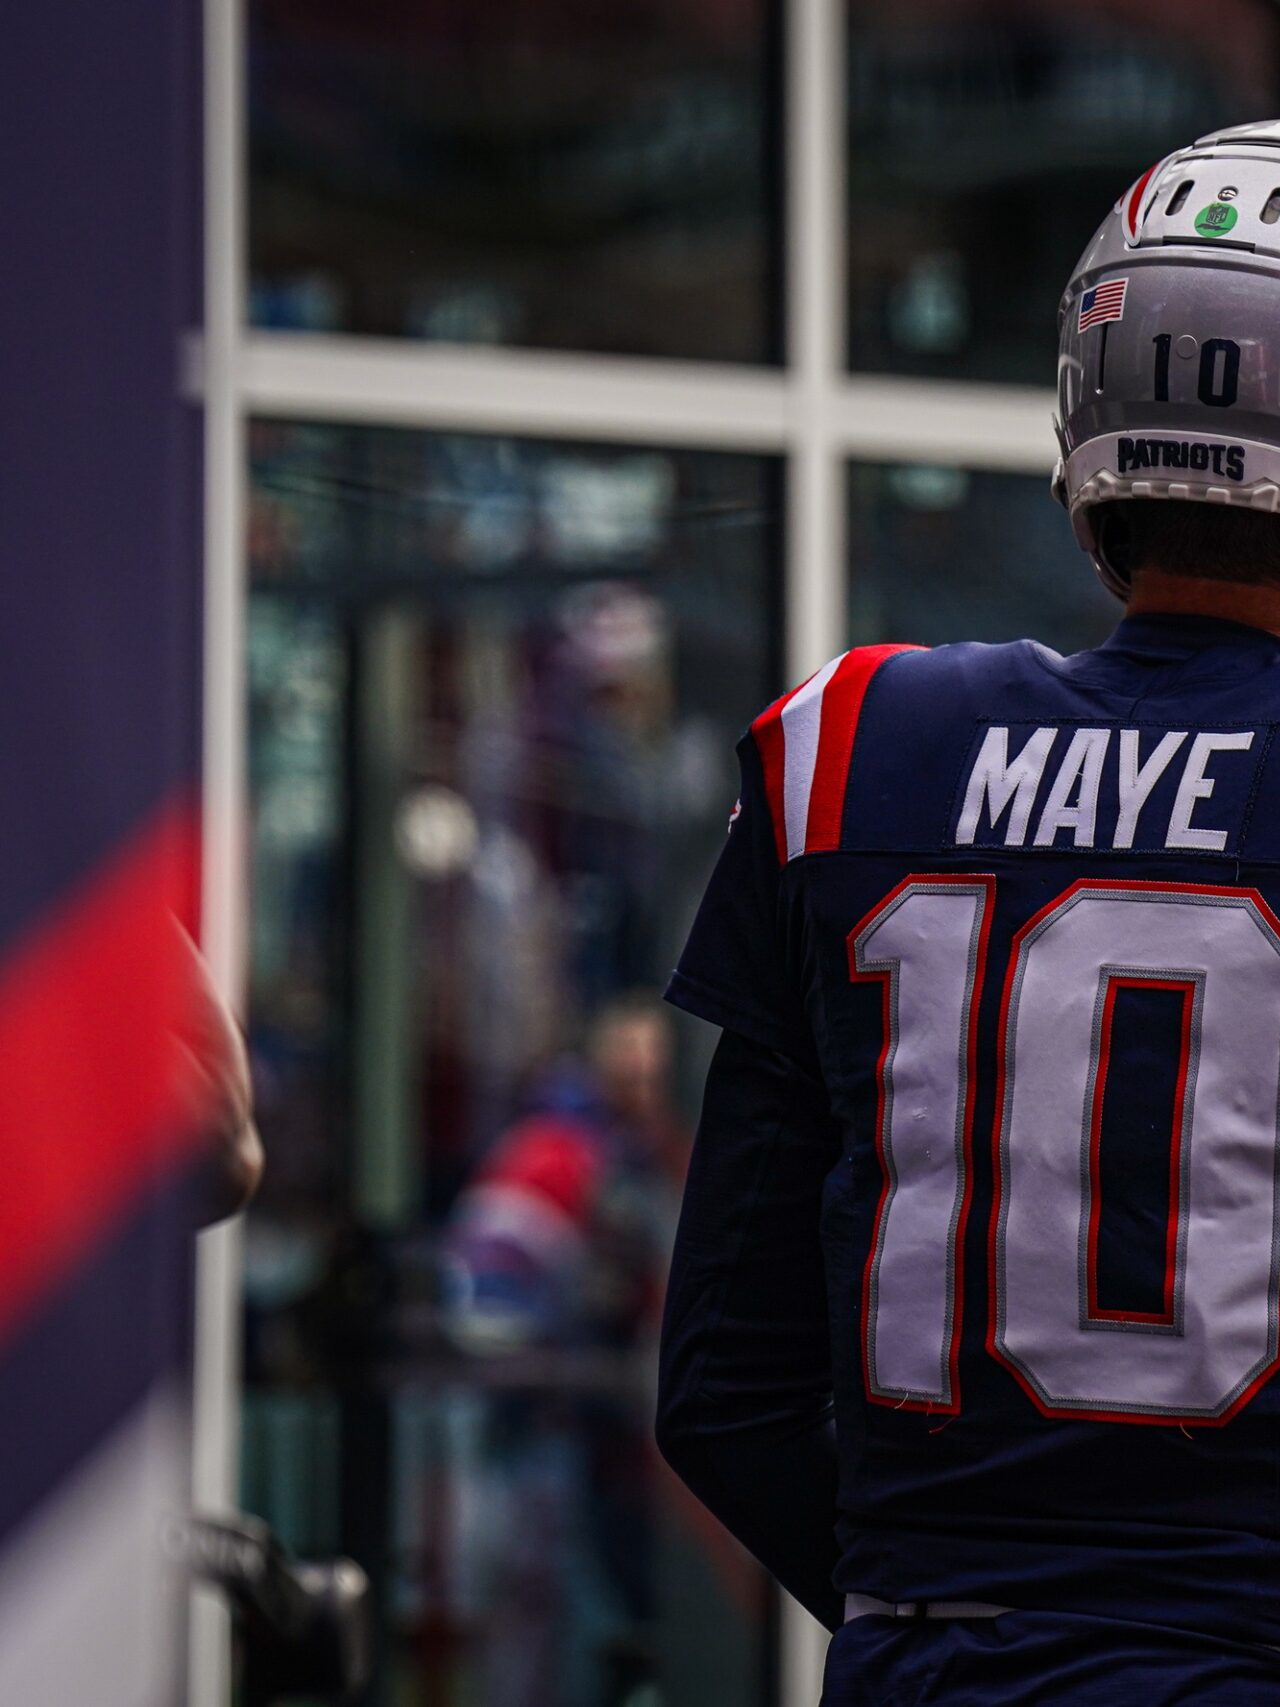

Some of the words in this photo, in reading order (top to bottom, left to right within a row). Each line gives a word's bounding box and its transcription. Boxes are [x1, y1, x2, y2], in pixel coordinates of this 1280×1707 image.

[1153, 333, 1240, 407] 10
[1118, 438, 1245, 481] PATRIOTS
[955, 727, 1255, 851] MAYE
